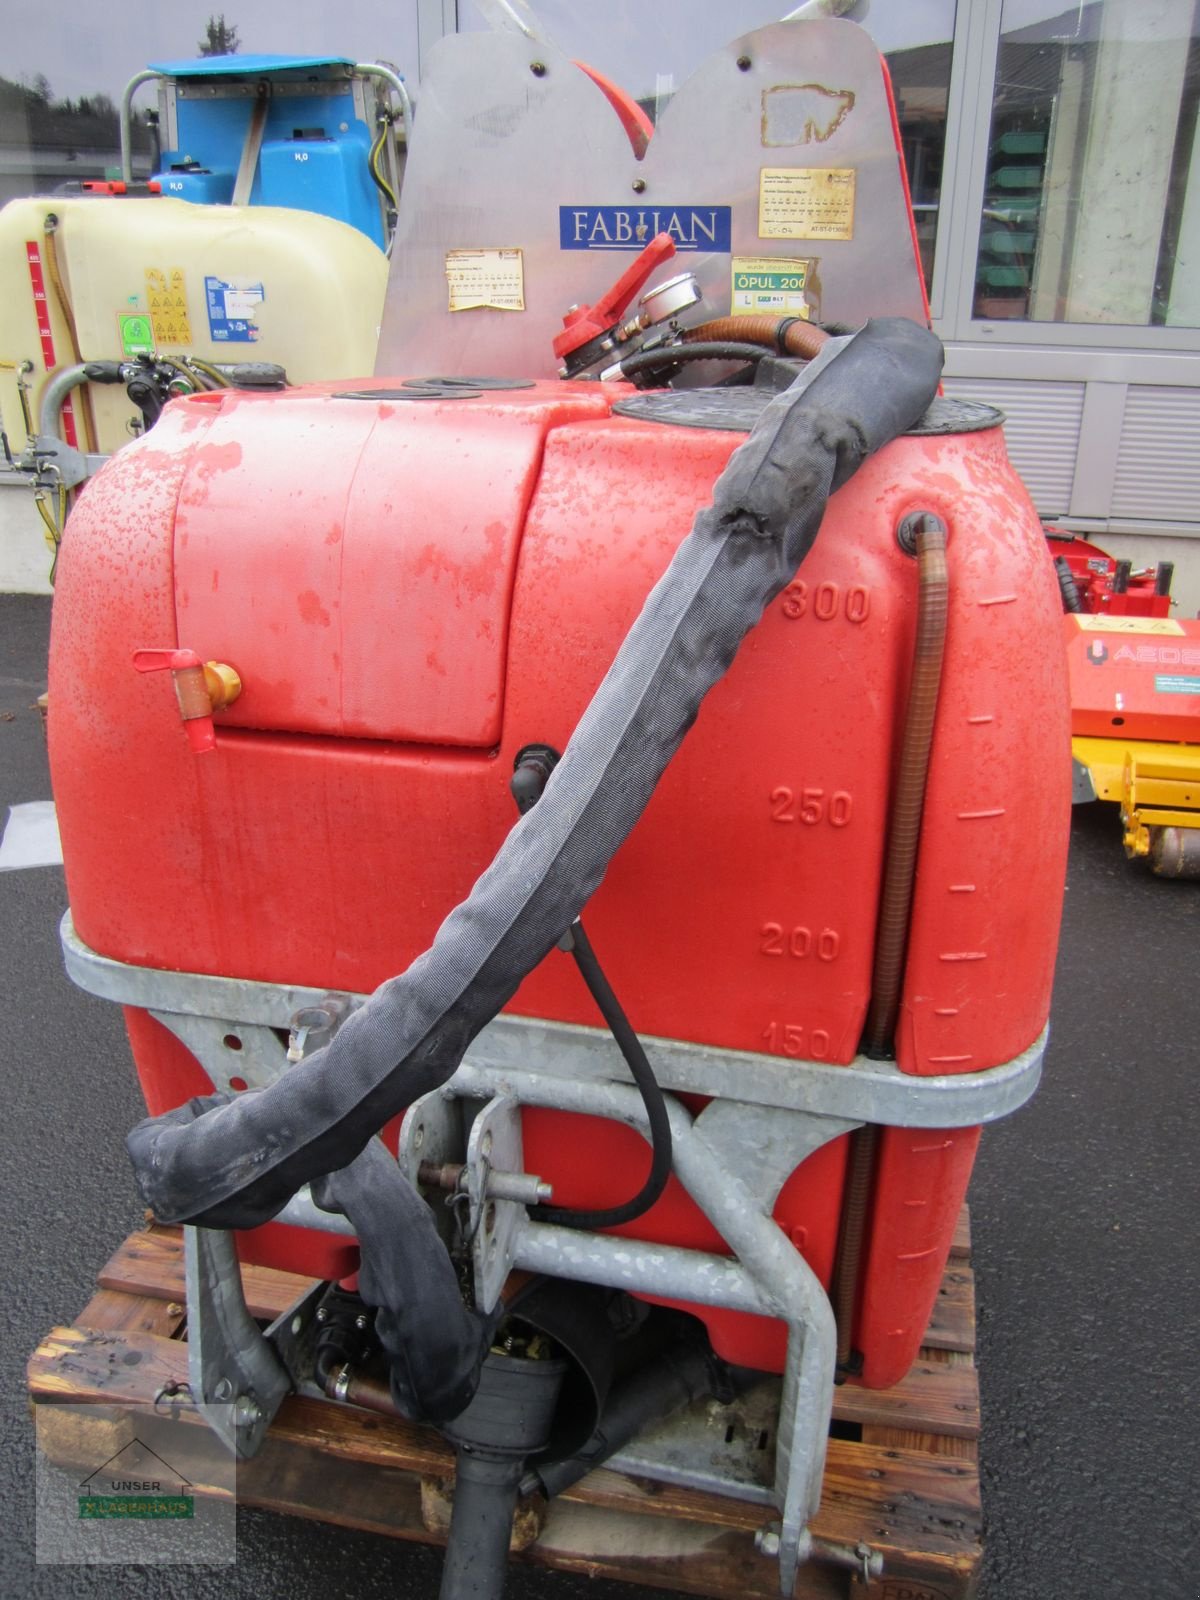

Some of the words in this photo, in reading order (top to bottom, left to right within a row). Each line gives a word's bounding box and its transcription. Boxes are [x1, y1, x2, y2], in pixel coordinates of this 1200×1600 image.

[738, 275, 776, 289] ÖPUL
[782, 578, 870, 623] 300
[769, 786, 853, 828] 250
[760, 921, 841, 962] 200
[760, 1020, 832, 1059] 150
